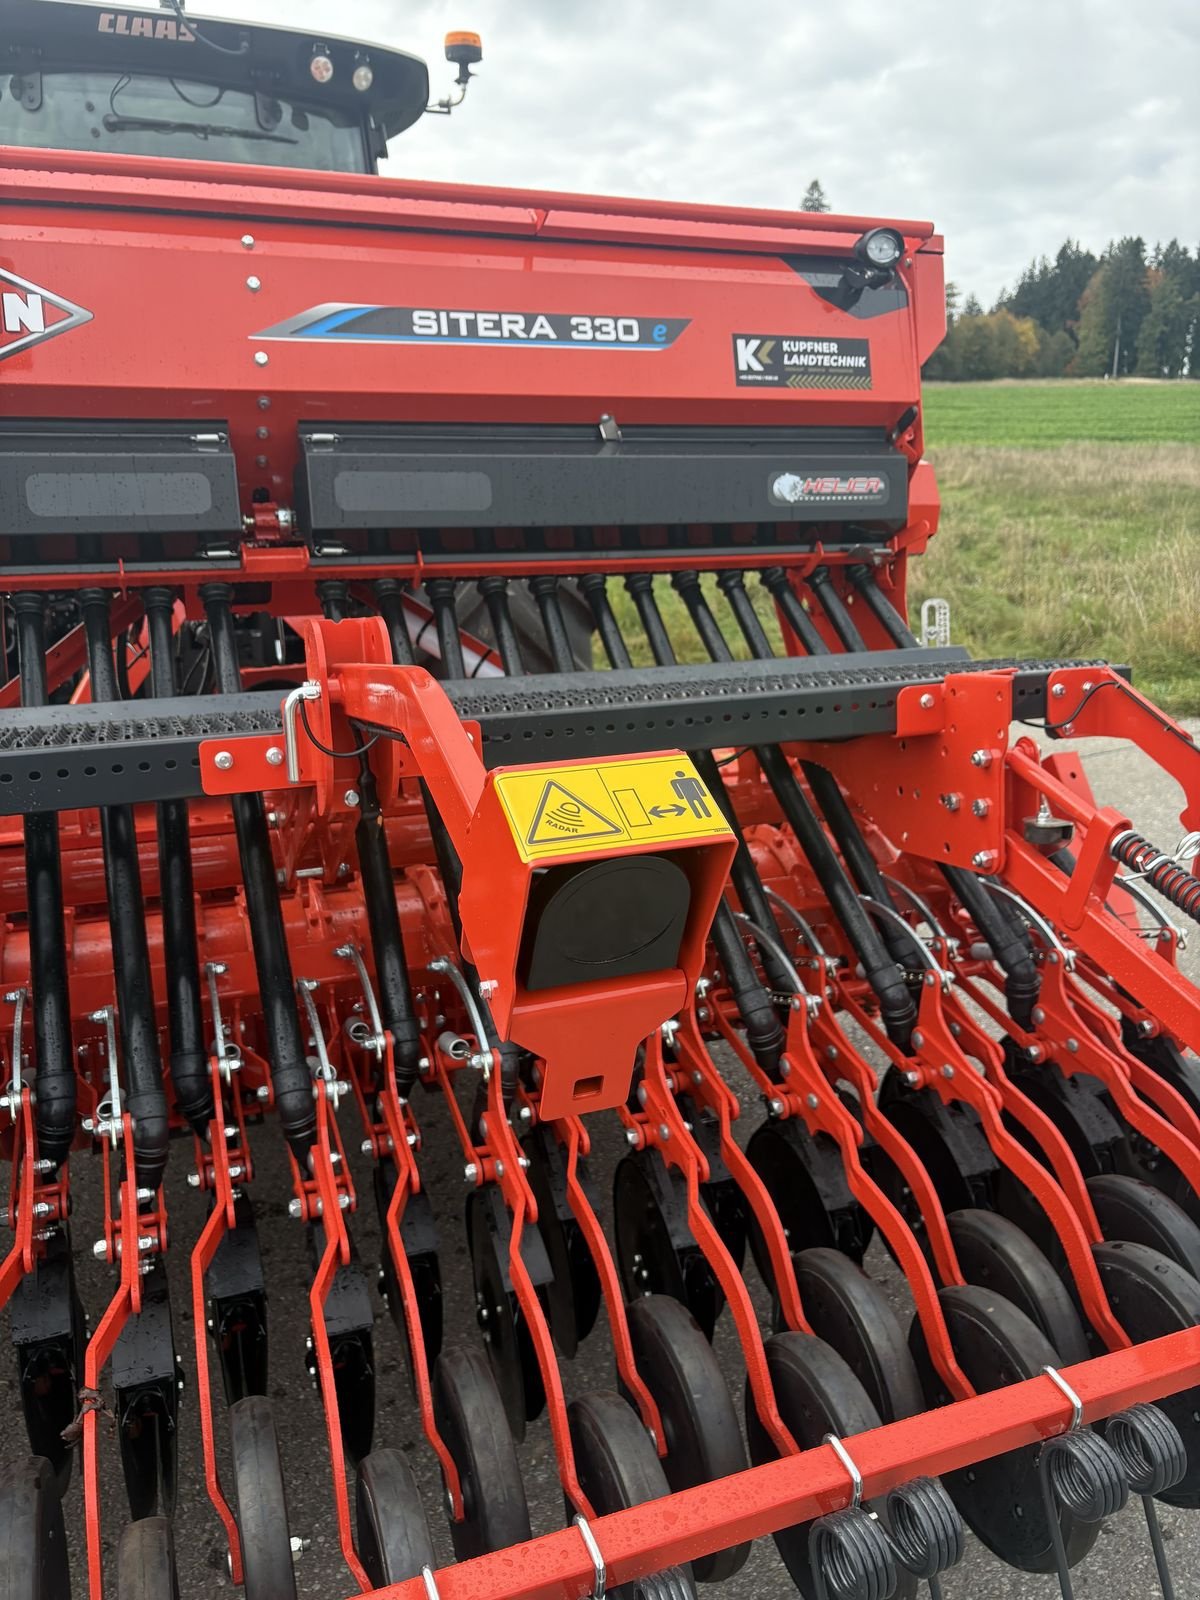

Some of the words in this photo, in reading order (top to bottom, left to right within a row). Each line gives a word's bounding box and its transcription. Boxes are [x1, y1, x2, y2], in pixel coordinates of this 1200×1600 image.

[98, 13, 197, 42] CLAAS
[412, 310, 557, 339] SITERA
[570, 316, 640, 342] 330
[653, 324, 667, 342] e
[782, 340, 838, 353] KUPFNER
[783, 354, 867, 367] LANDTECHNIK
[803, 477, 881, 493] HELICA
[545, 819, 579, 834] RADAR
